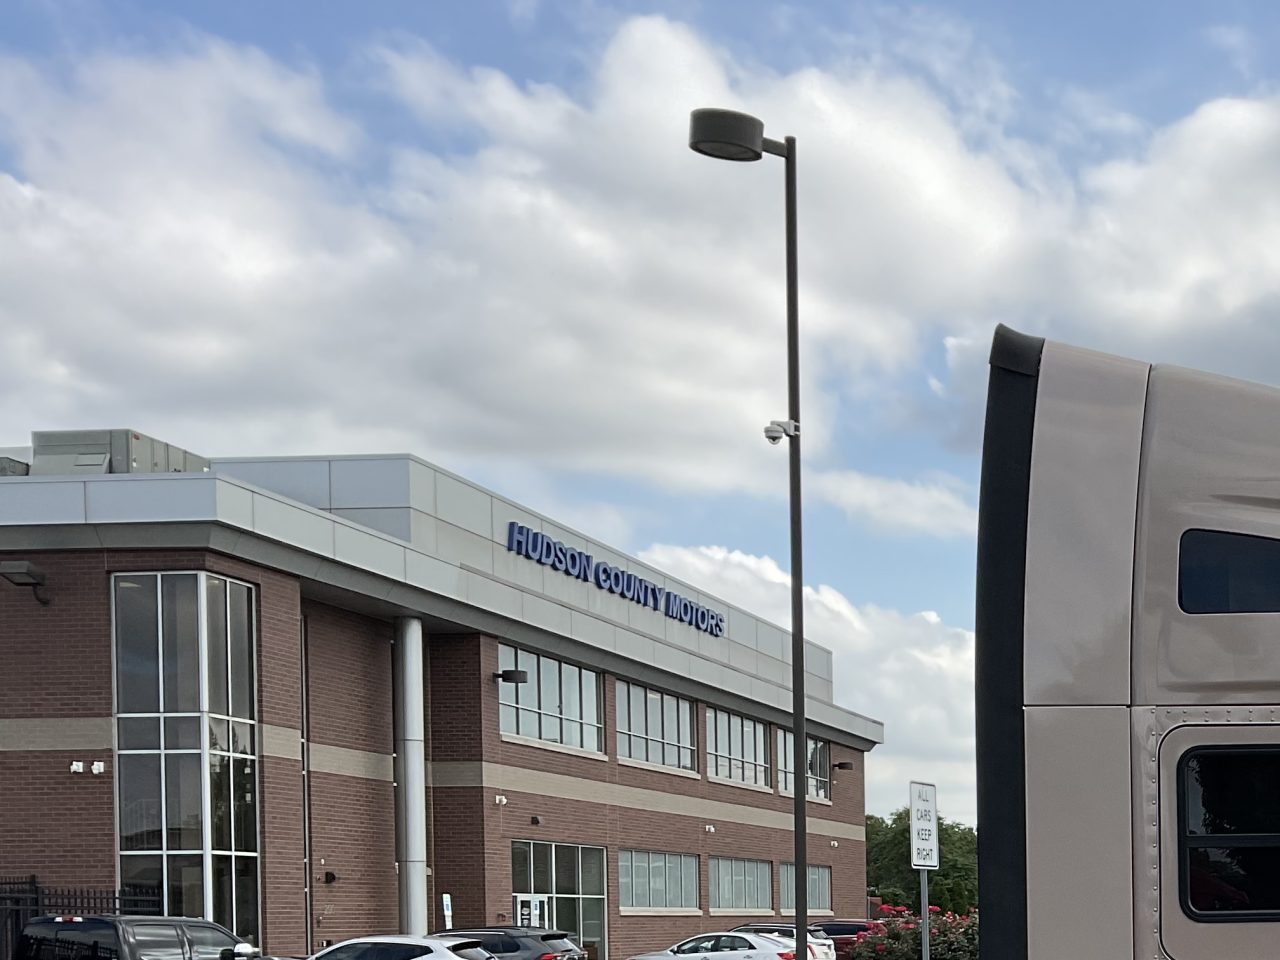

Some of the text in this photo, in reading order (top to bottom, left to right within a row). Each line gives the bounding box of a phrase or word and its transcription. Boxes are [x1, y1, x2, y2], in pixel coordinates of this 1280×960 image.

[508, 522, 725, 637] HUDSON COUNTY MOTORS
[918, 789, 929, 802] ALL
[917, 809, 931, 822] CARS
[917, 828, 931, 841] KEEP
[917, 848, 933, 861] RIGHT
